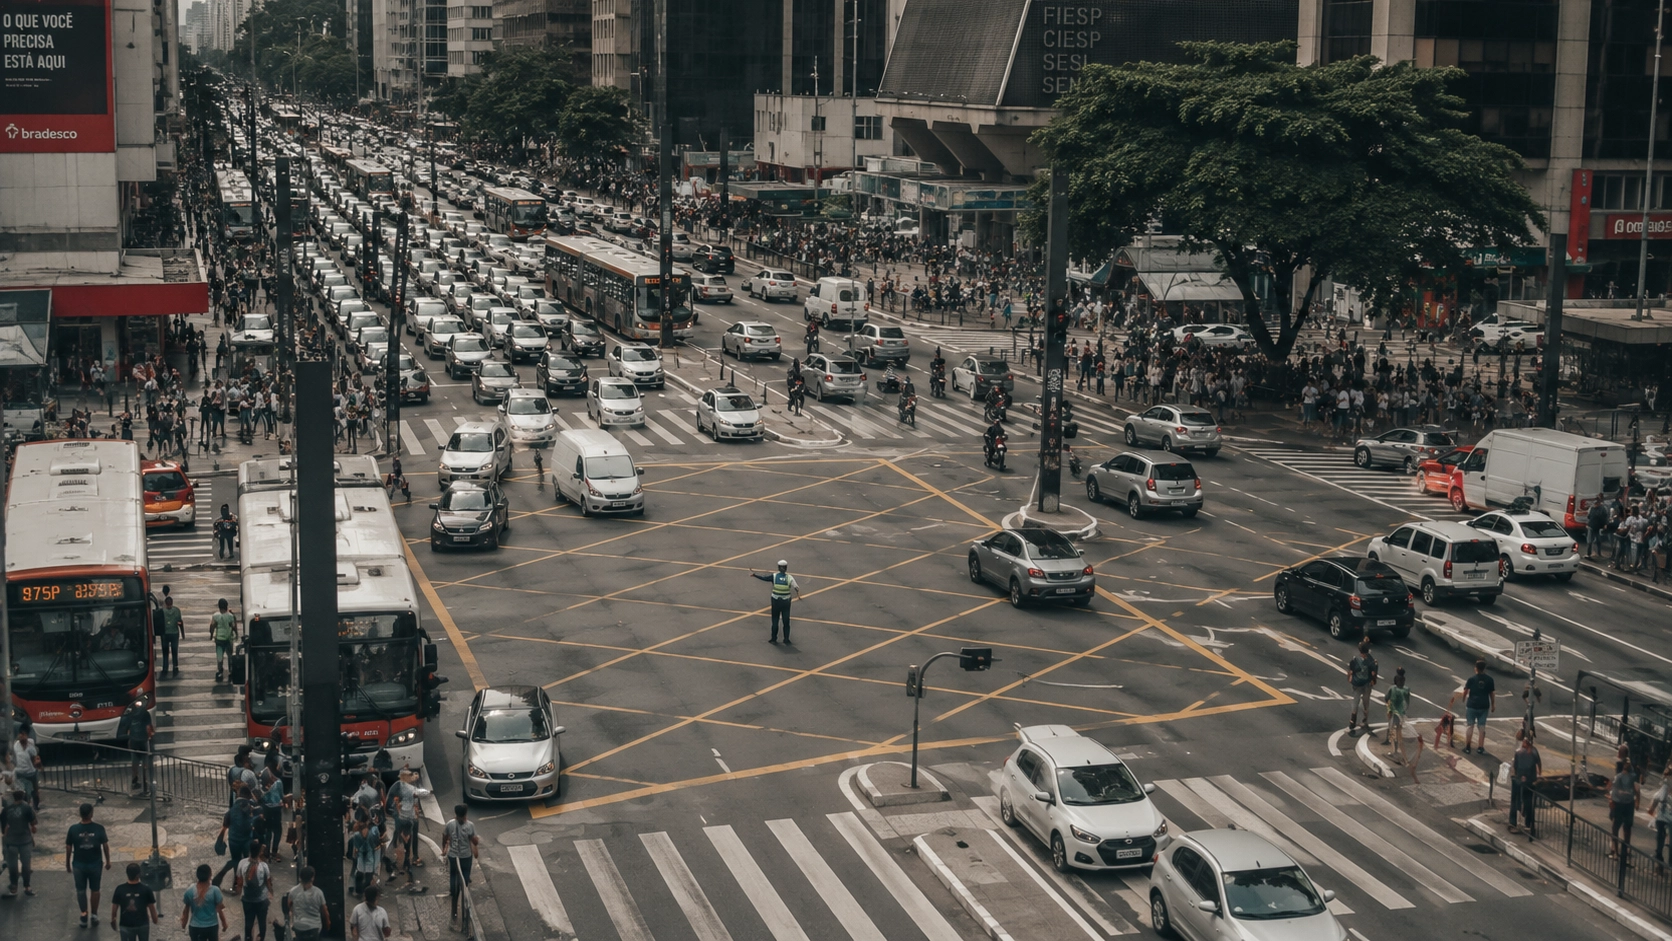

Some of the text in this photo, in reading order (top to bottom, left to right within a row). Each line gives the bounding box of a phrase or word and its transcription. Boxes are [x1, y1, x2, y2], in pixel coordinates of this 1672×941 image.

[3, 13, 11, 28] O
[15, 13, 39, 31] QUE
[1043, 6, 1102, 25] FIESP
[4, 34, 54, 49] PRECISA
[1043, 29, 1101, 48] CIESP
[4, 51, 66, 71] ESTÁ AQUI
[21, 127, 78, 139] bradesco
